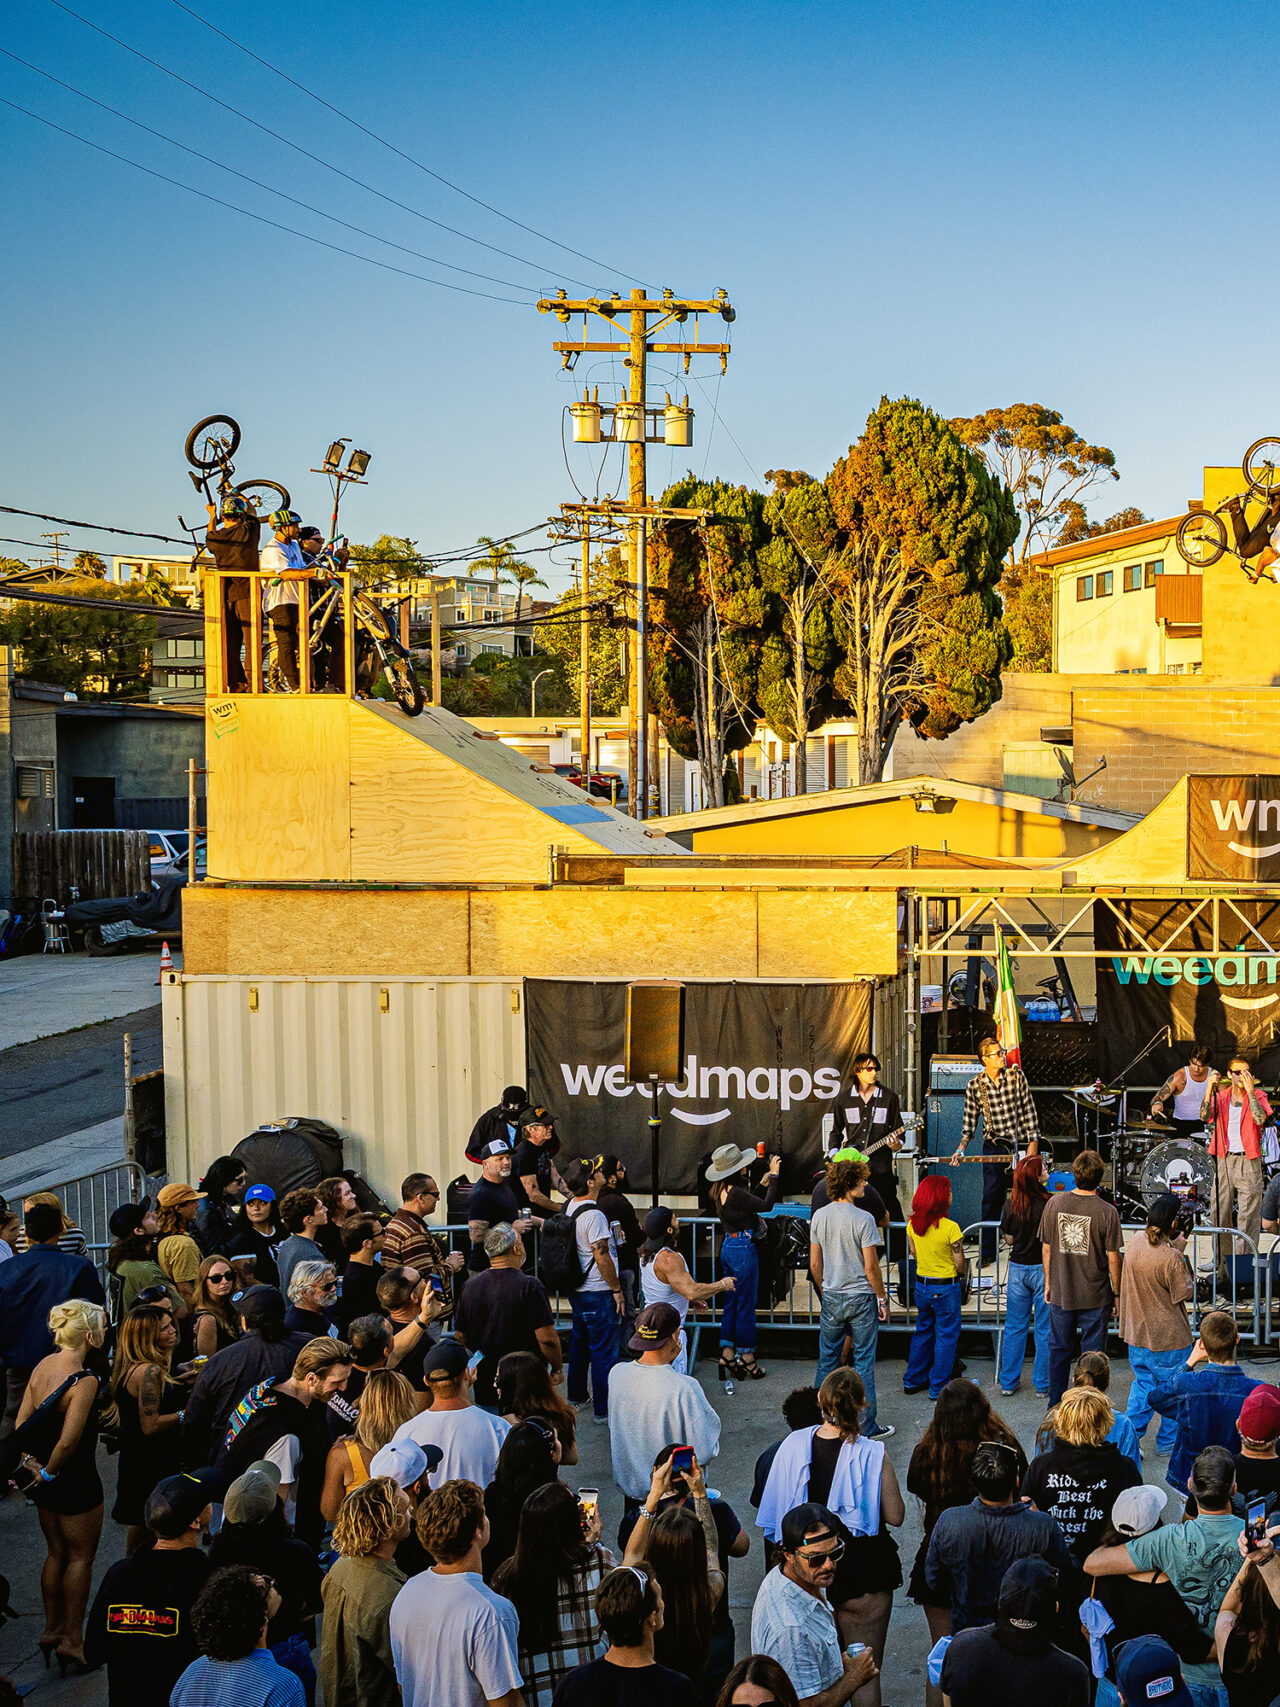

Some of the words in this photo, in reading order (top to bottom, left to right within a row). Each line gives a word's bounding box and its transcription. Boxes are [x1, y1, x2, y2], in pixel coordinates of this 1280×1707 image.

[212, 702, 233, 715] wm
[1057, 1490, 1092, 1503] Best
[1083, 1506, 1104, 1521] the
